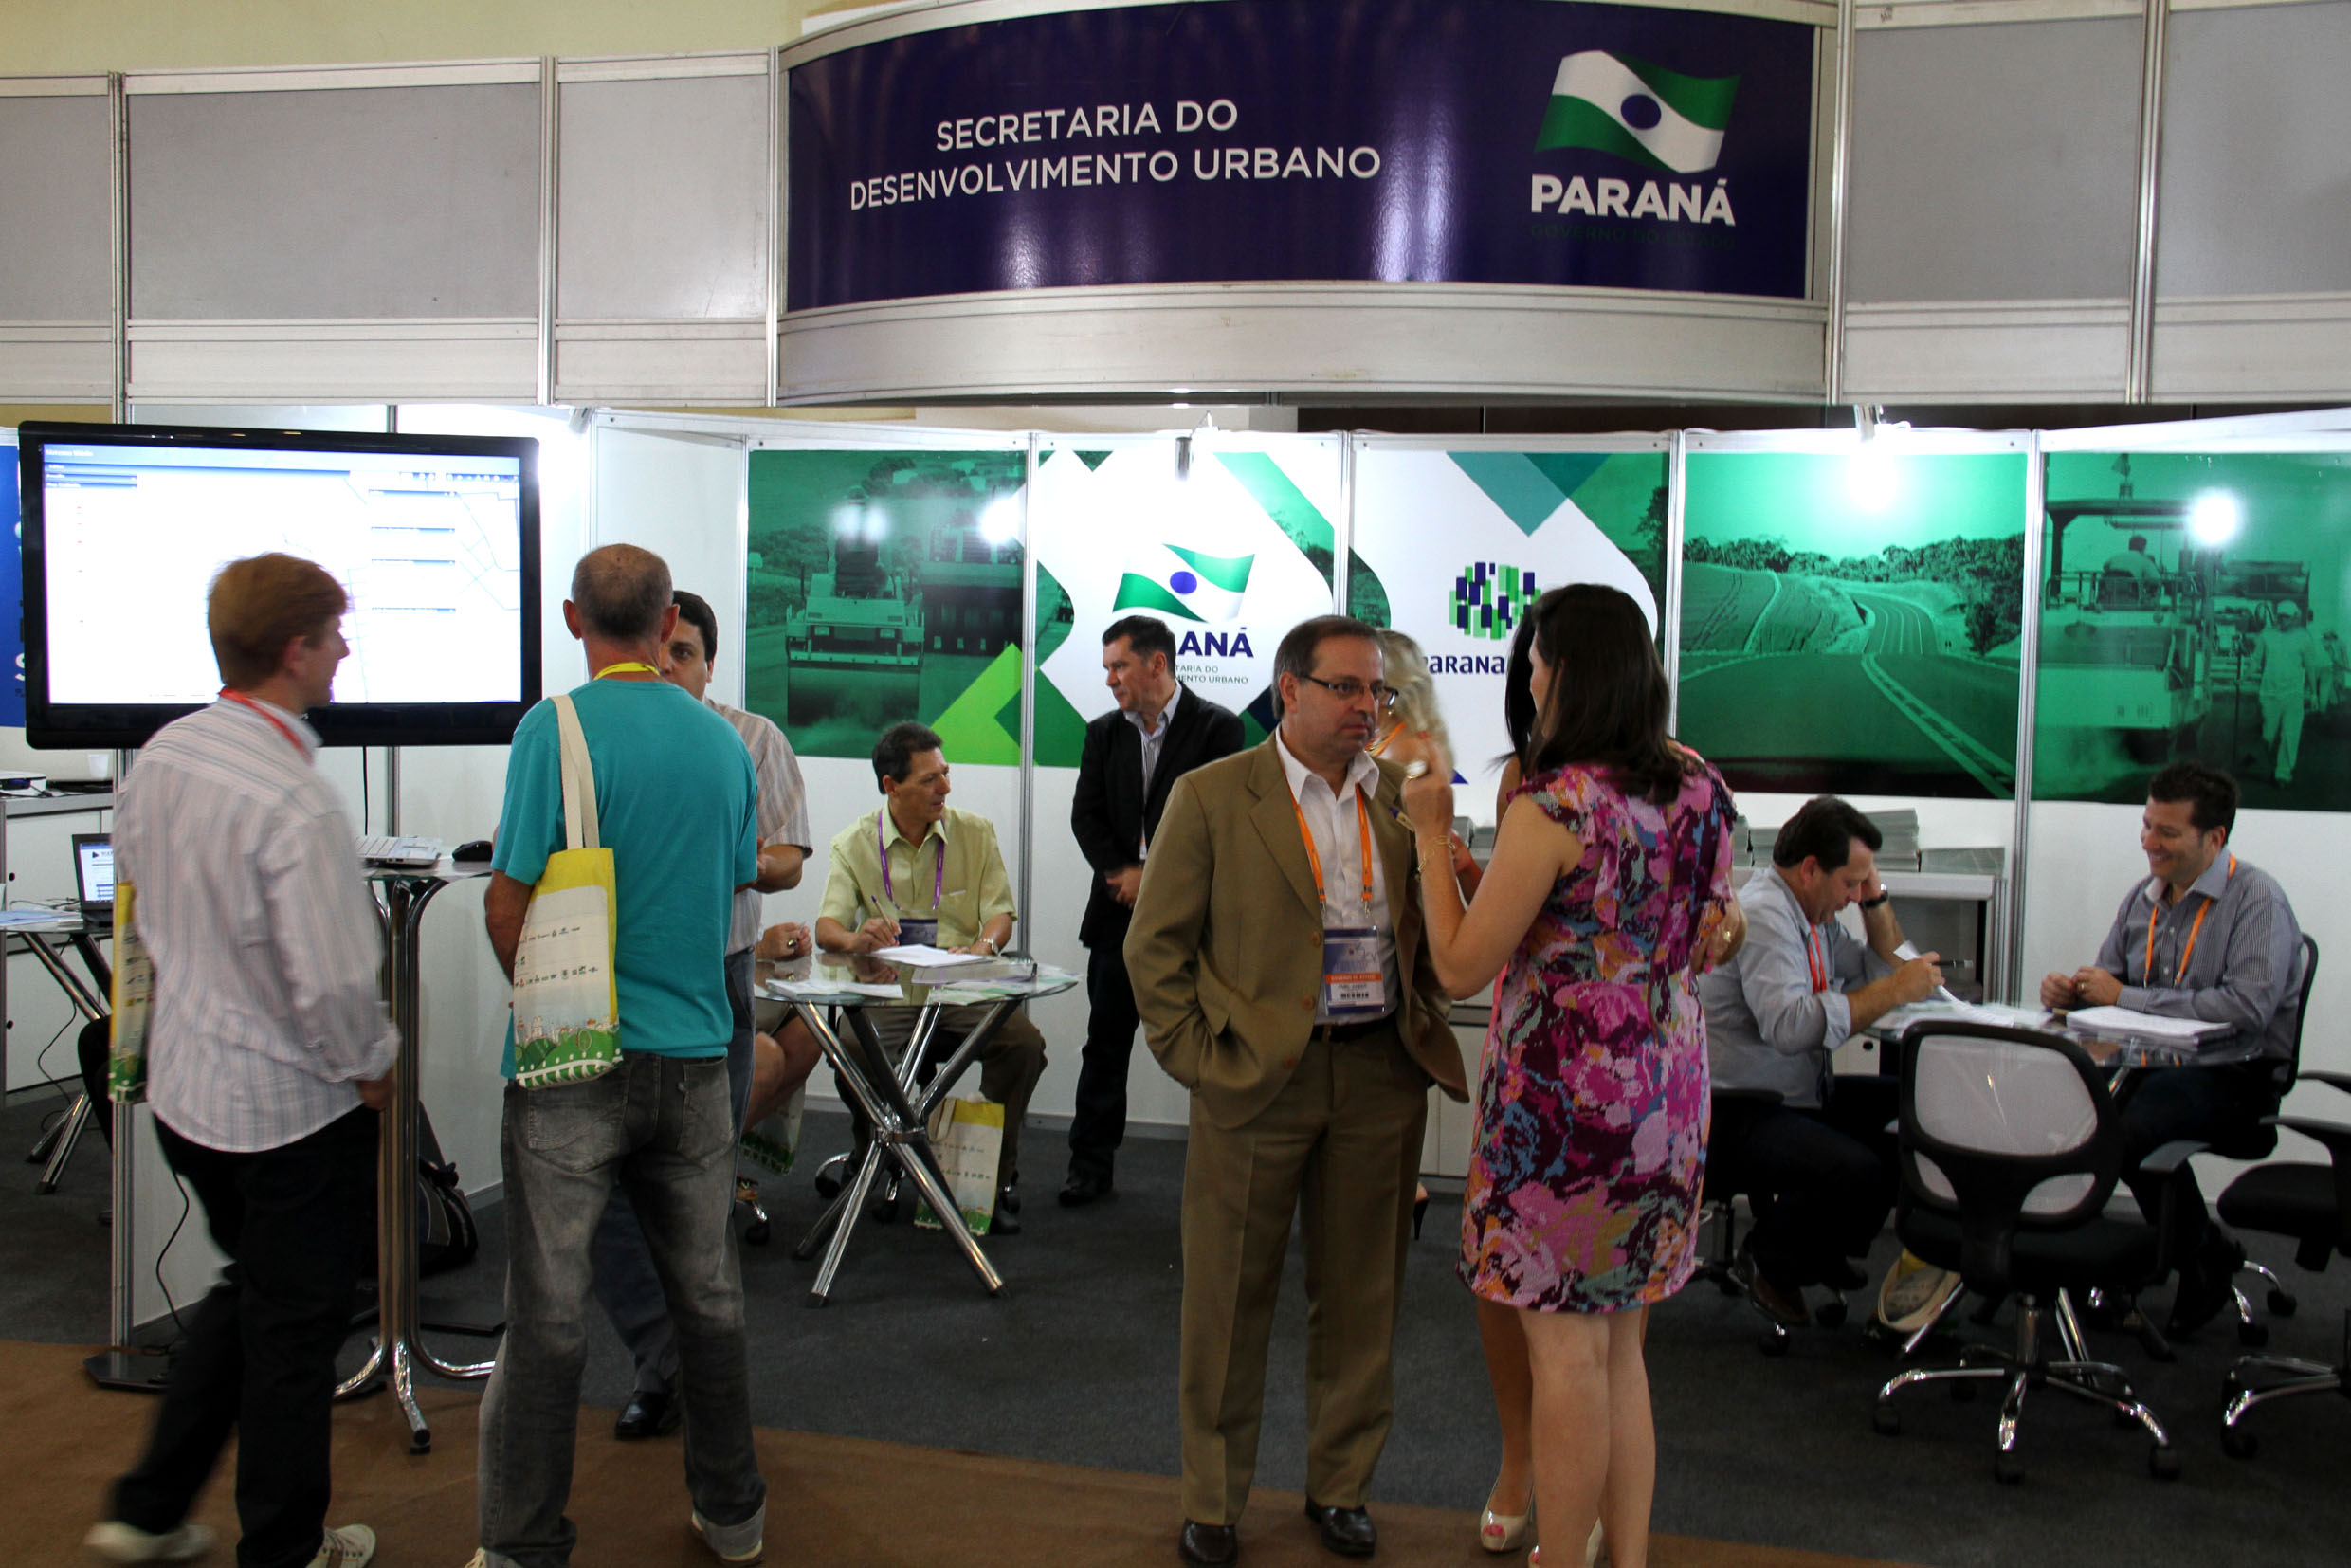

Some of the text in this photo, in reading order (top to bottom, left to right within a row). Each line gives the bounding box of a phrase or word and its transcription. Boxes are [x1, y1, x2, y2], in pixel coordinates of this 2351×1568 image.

[936, 98, 1238, 152] SECRETARIA DO
[849, 146, 1381, 211] DESENVOLVIMENTO URBANO
[1530, 173, 1737, 227] PARANÁ
[1177, 626, 1255, 658] ANÁ
[1176, 664, 1219, 674] TARIA DO
[1208, 675, 1248, 684] URBANO
